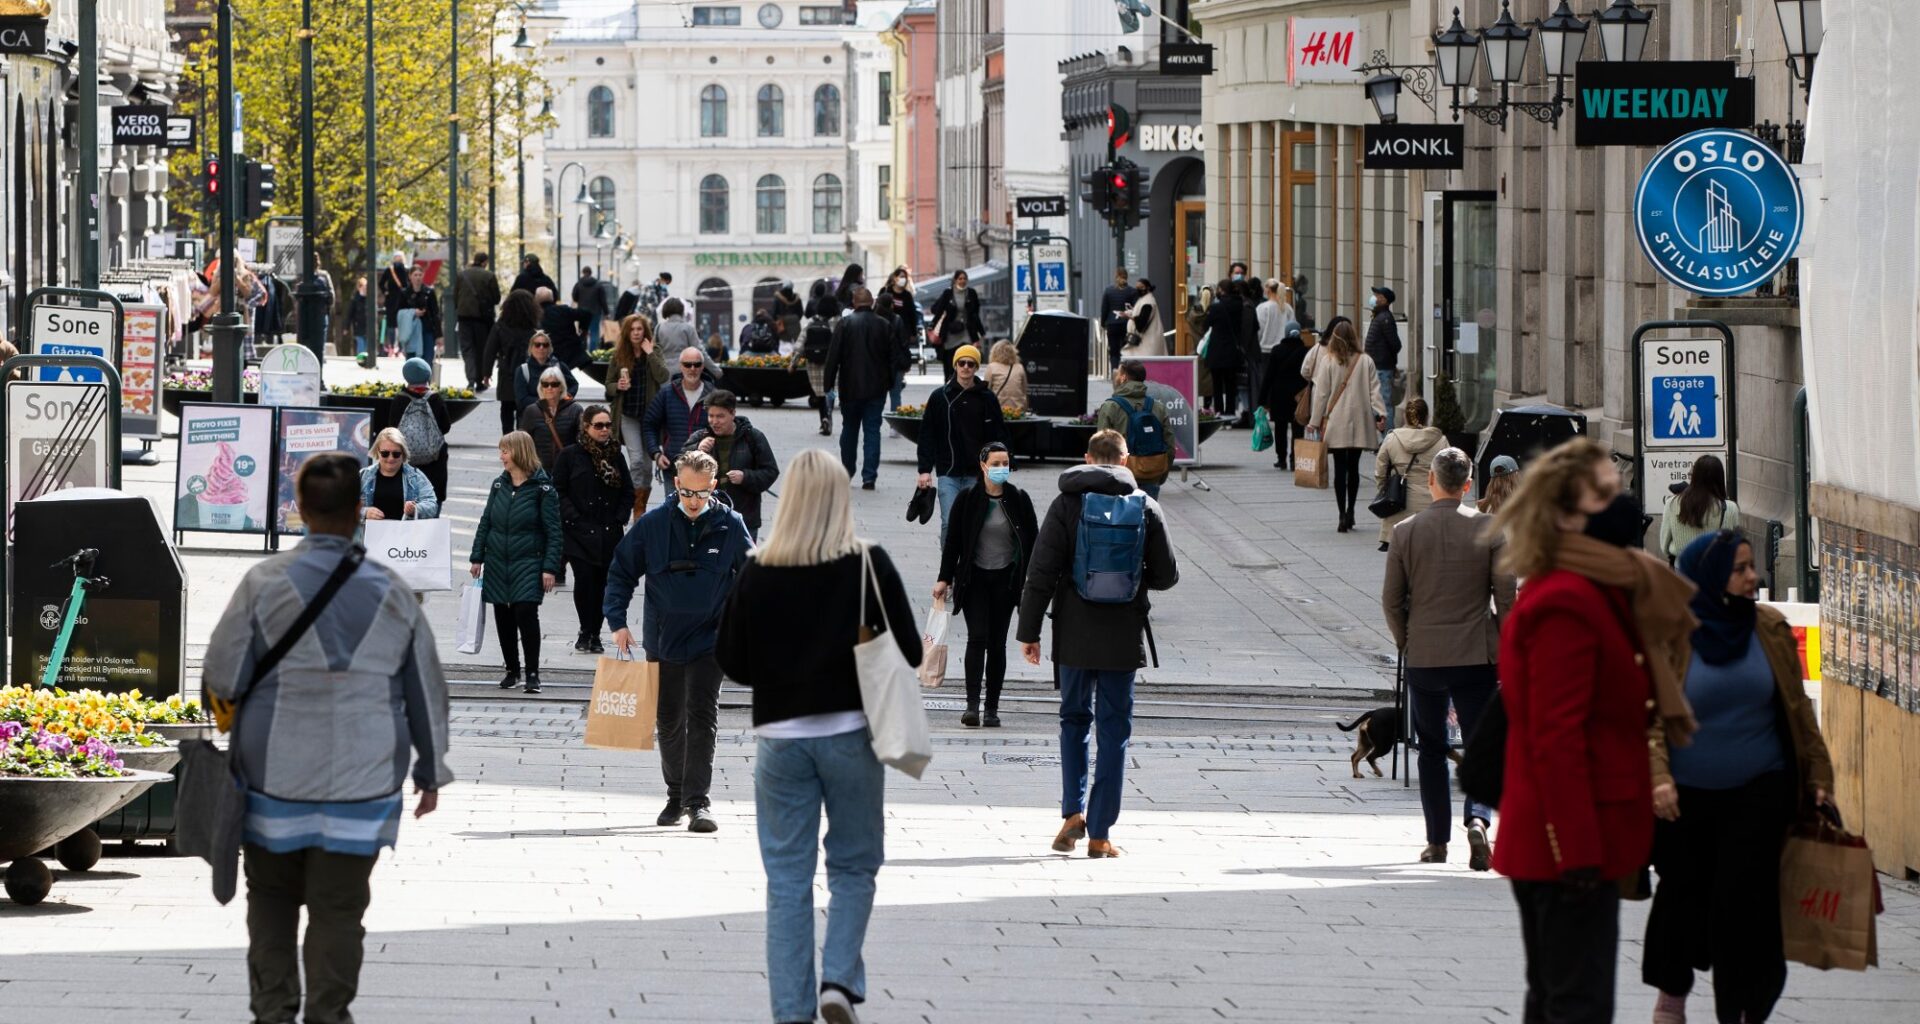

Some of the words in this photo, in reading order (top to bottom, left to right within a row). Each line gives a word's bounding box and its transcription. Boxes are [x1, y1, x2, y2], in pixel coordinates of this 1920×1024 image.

[0, 28, 32, 47] CA
[1301, 31, 1354, 67] H&M
[1582, 88, 1729, 119] WEEKDAY
[118, 114, 160, 125] VERO
[116, 125, 162, 136] MODA
[1368, 138, 1454, 156] MONKI
[1673, 141, 1765, 173] OSLO
[1021, 200, 1060, 213] VOLT
[694, 251, 846, 266] ØSTBANEHALLEN
[1039, 248, 1062, 258] Sone
[1654, 229, 1784, 281] STILLASUTLEIE
[47, 313, 100, 336] Sone
[1657, 346, 1710, 365] Sone
[1662, 377, 1705, 391] Gågate
[25, 393, 90, 421] Sone
[1166, 398, 1184, 410] off
[192, 421, 216, 429] FROYO
[191, 432, 236, 441] EVERYTHING
[387, 546, 428, 559] Cubus
[74, 615, 89, 625] slo
[71, 656, 95, 664] holder
[96, 656, 103, 664] vi
[103, 656, 121, 664] Oslo
[63, 665, 92, 674] beskjed
[93, 665, 101, 673] til
[596, 690, 637, 705] JACK&
[594, 702, 637, 718] JONES
[1798, 887, 1841, 922] HM
